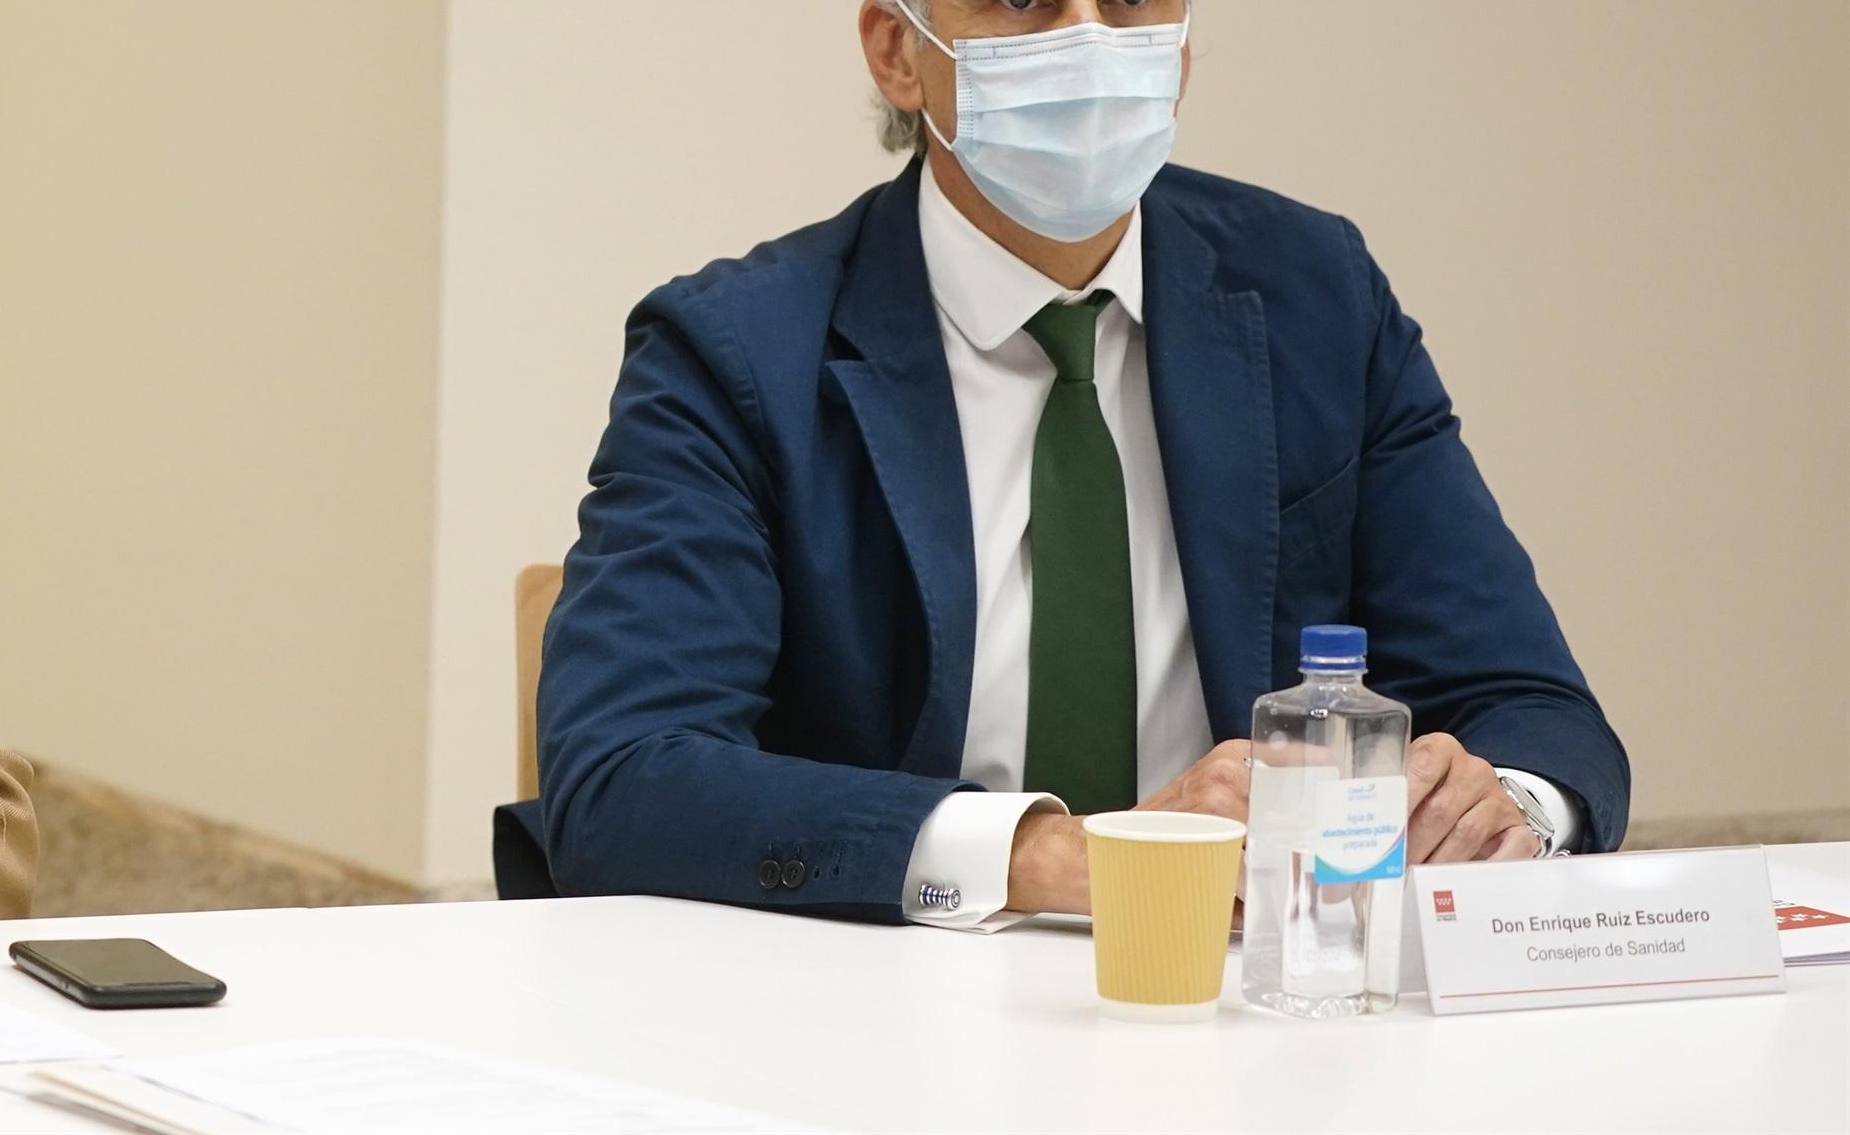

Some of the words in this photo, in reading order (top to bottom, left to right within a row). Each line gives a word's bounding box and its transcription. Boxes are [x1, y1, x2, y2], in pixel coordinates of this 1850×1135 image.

[1491, 918, 1524, 934] Don
[1529, 915, 1592, 933] Enrique
[1597, 911, 1632, 928] Ruiz
[1636, 908, 1711, 926] Escudero
[1527, 943, 1601, 963] Consejero
[1605, 941, 1623, 957] de
[1627, 937, 1686, 956] Sanidad
